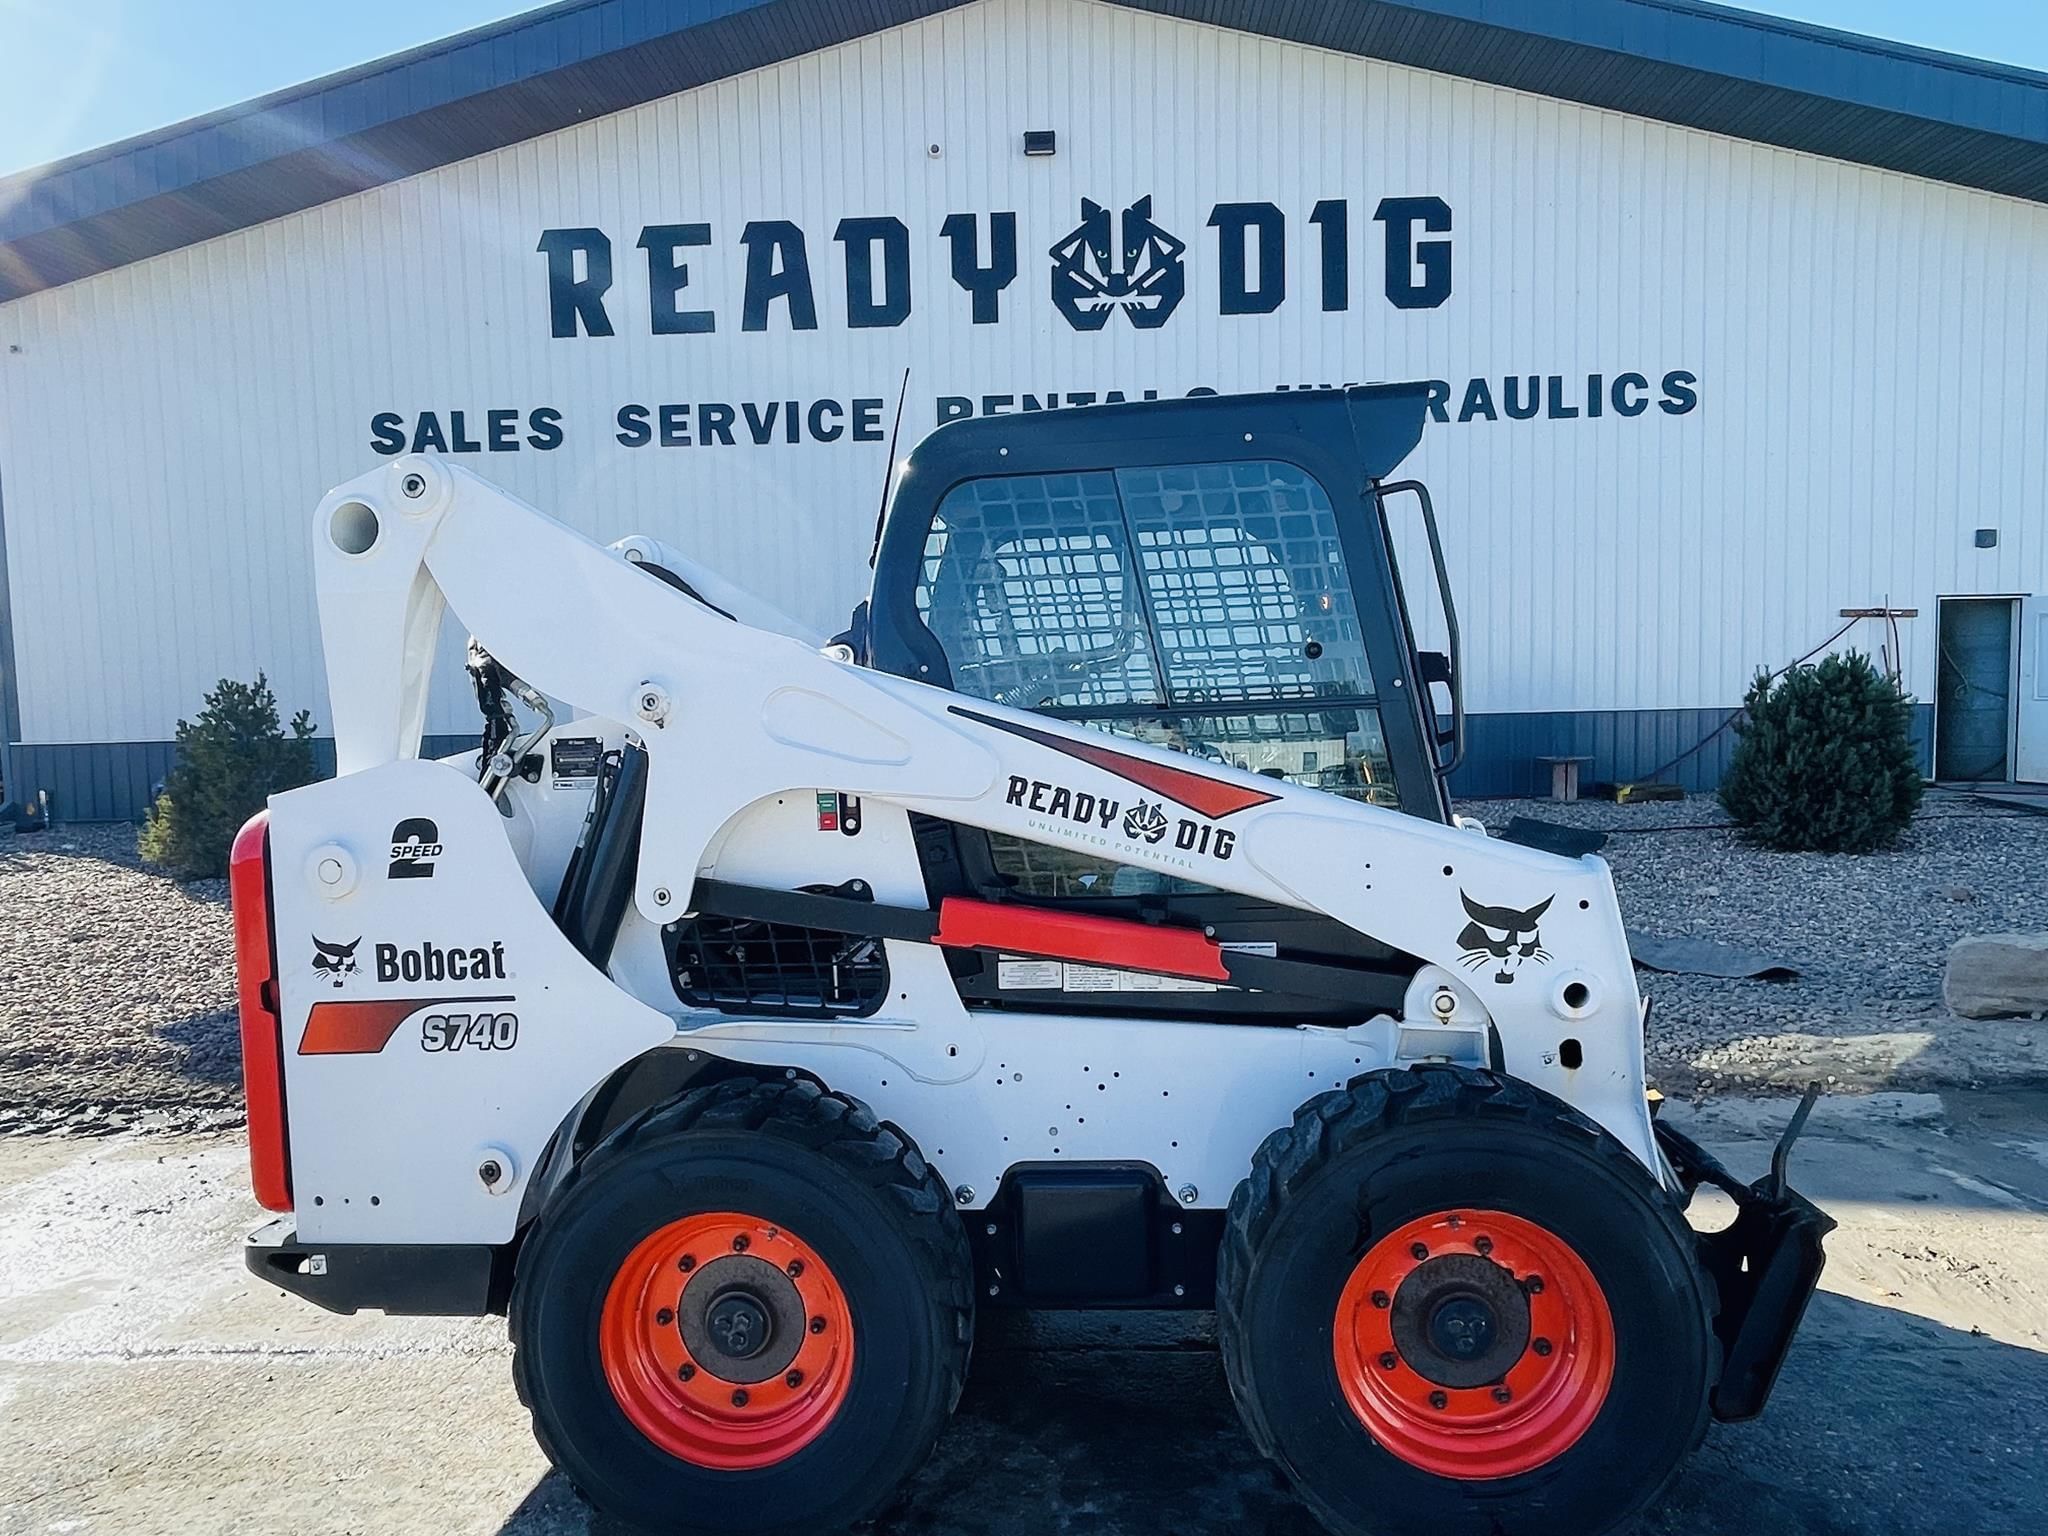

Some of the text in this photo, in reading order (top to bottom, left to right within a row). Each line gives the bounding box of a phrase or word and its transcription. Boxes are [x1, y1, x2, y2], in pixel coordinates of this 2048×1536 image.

[537, 196, 1452, 338] READY DIG
[370, 407, 564, 455] SALES
[616, 398, 884, 448] SERVICE
[1005, 775, 1236, 861] READY DIG
[1028, 819, 1194, 869] UNLIMITED POTENTIAL
[388, 818, 443, 878] 2 SPEED
[375, 941, 506, 982] Bobcat
[421, 1012, 518, 1052] S740
